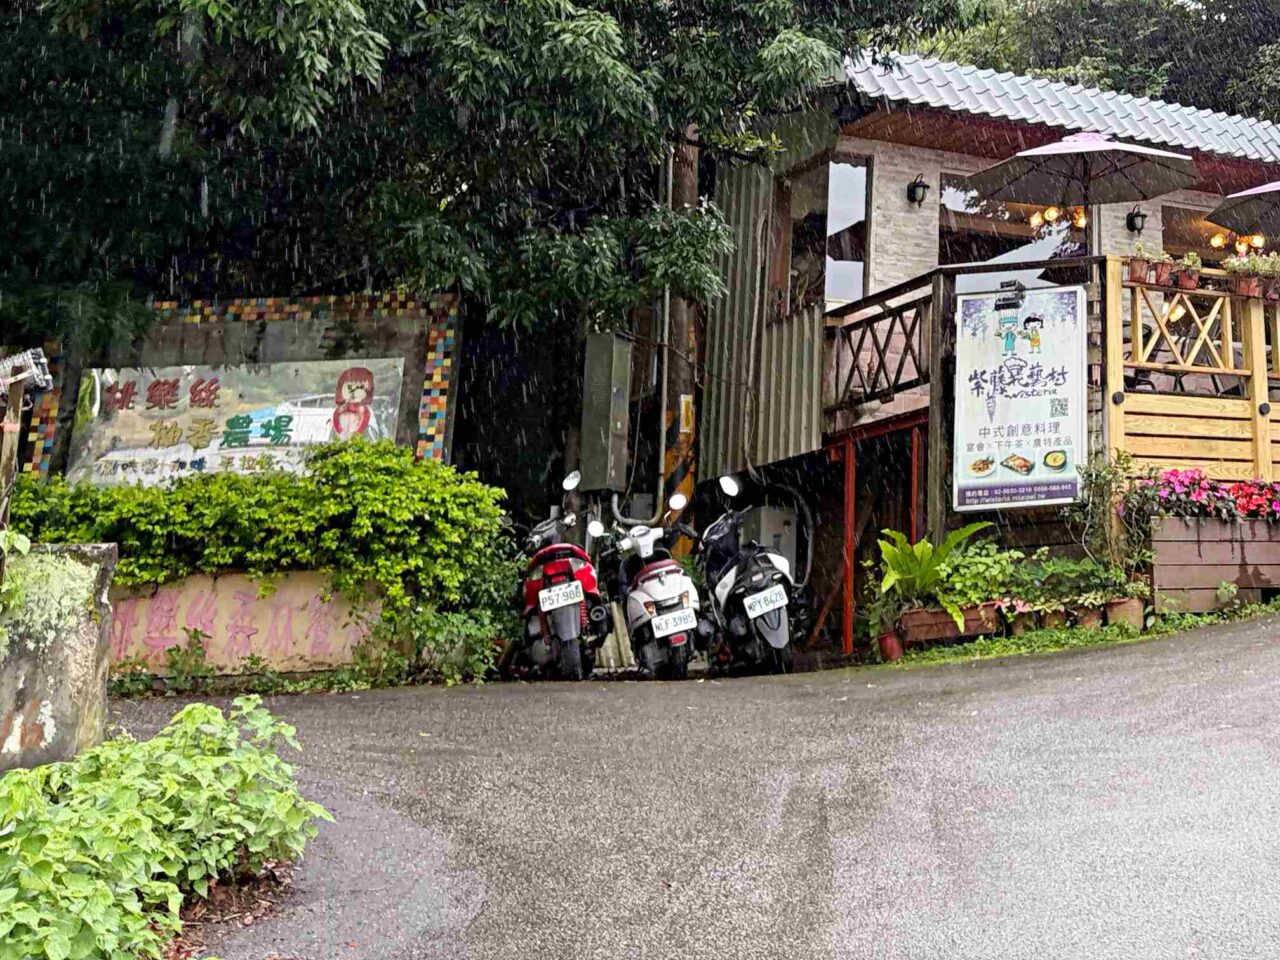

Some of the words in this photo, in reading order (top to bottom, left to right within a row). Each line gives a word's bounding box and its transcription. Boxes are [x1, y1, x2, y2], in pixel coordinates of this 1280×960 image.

[149, 414, 294, 450] 柚香農場
[979, 421, 1061, 439] 中式創意料理
